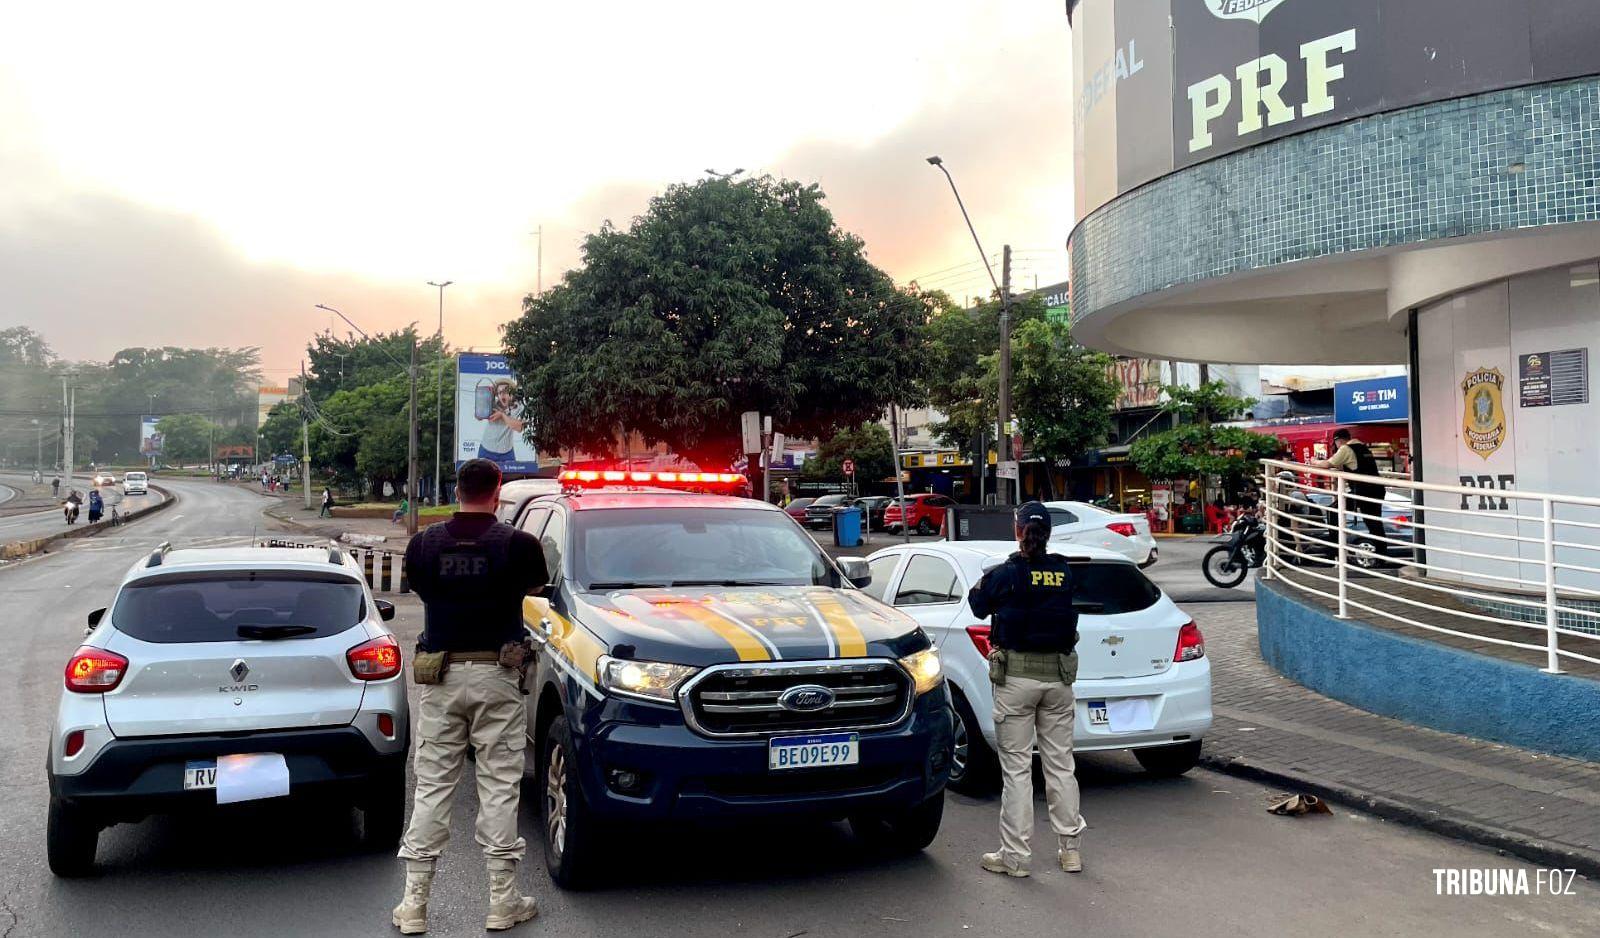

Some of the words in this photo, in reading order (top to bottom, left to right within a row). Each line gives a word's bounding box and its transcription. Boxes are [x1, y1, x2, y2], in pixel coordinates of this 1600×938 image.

[1188, 28, 1356, 153] PRF
[1352, 391, 1365, 405] 5G
[1377, 388, 1397, 401] TIM
[1460, 474, 1514, 510] PRF
[440, 557, 486, 576] PRF
[1031, 571, 1065, 587] PRF
[219, 684, 259, 693] KWID
[795, 692, 823, 705] Ford
